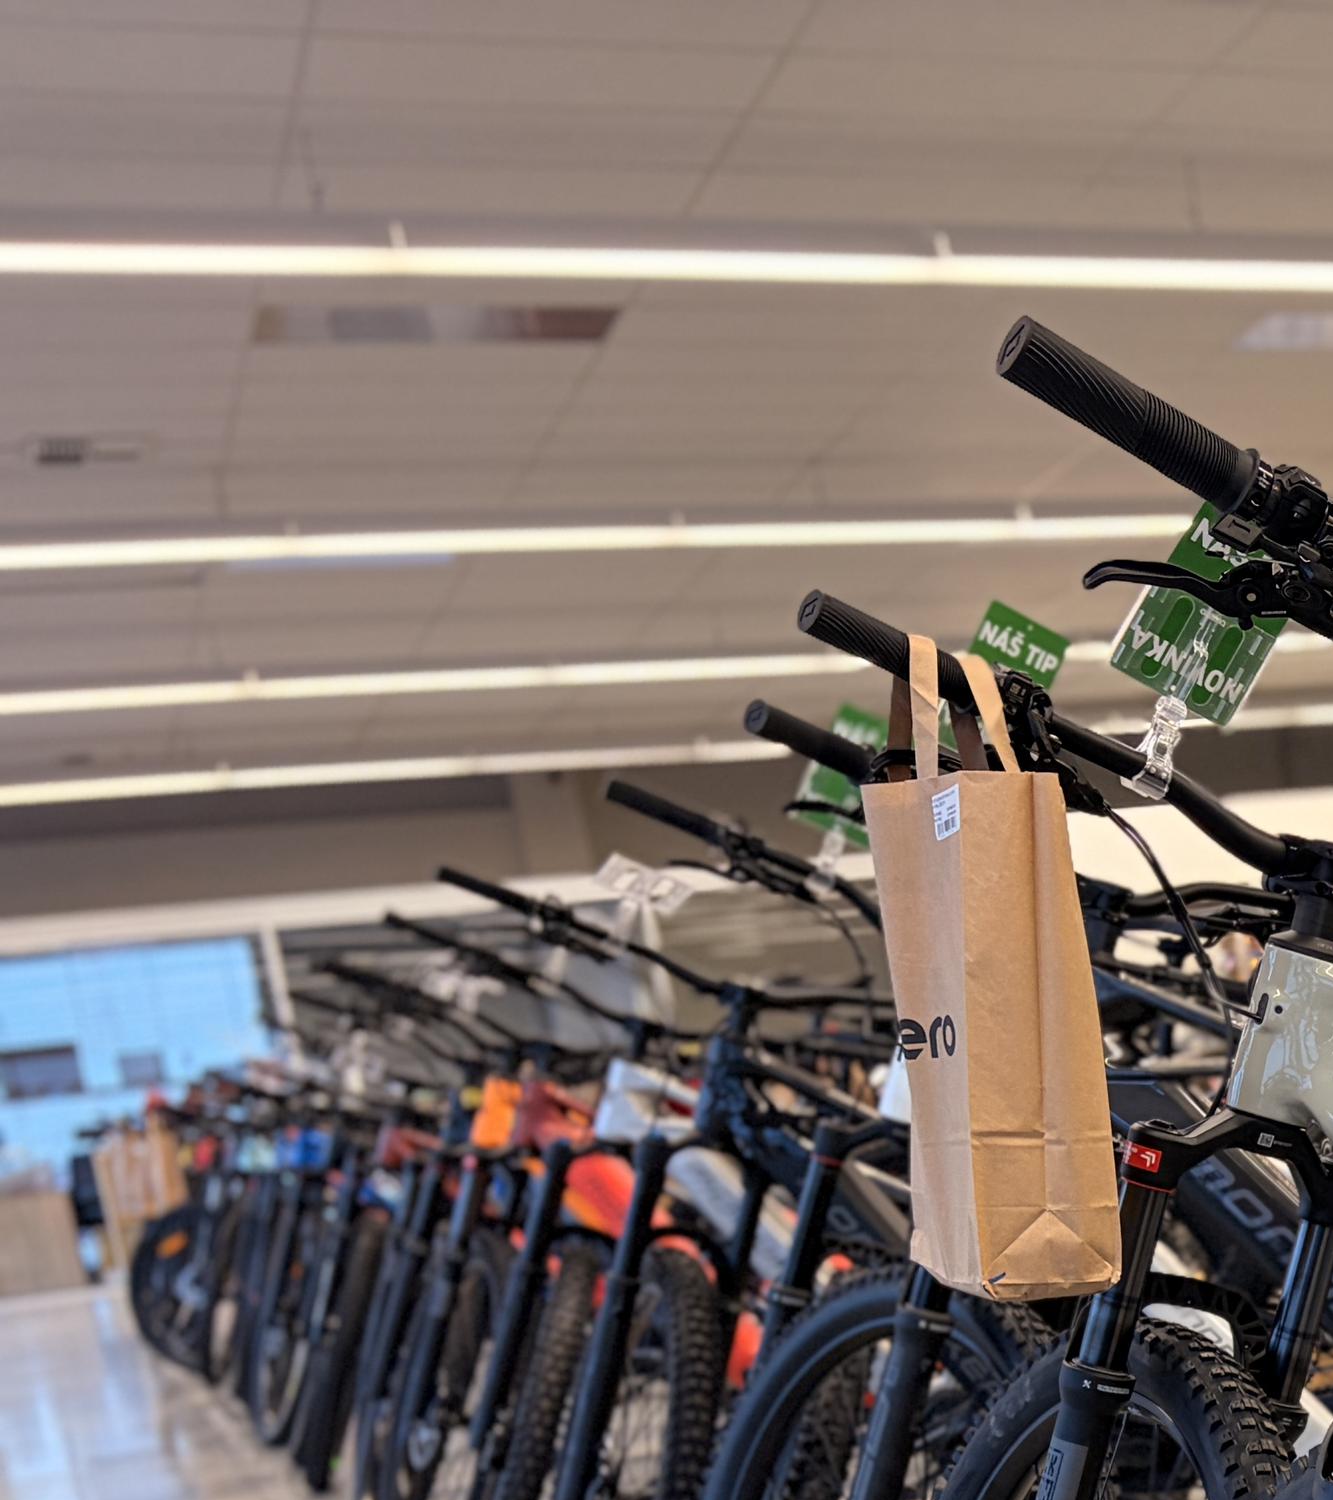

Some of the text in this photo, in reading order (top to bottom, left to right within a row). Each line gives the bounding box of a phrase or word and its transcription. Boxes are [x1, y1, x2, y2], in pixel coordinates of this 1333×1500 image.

[978, 620, 1060, 674] NÁŠ TIP
[1129, 625, 1245, 706] NOVINKA
